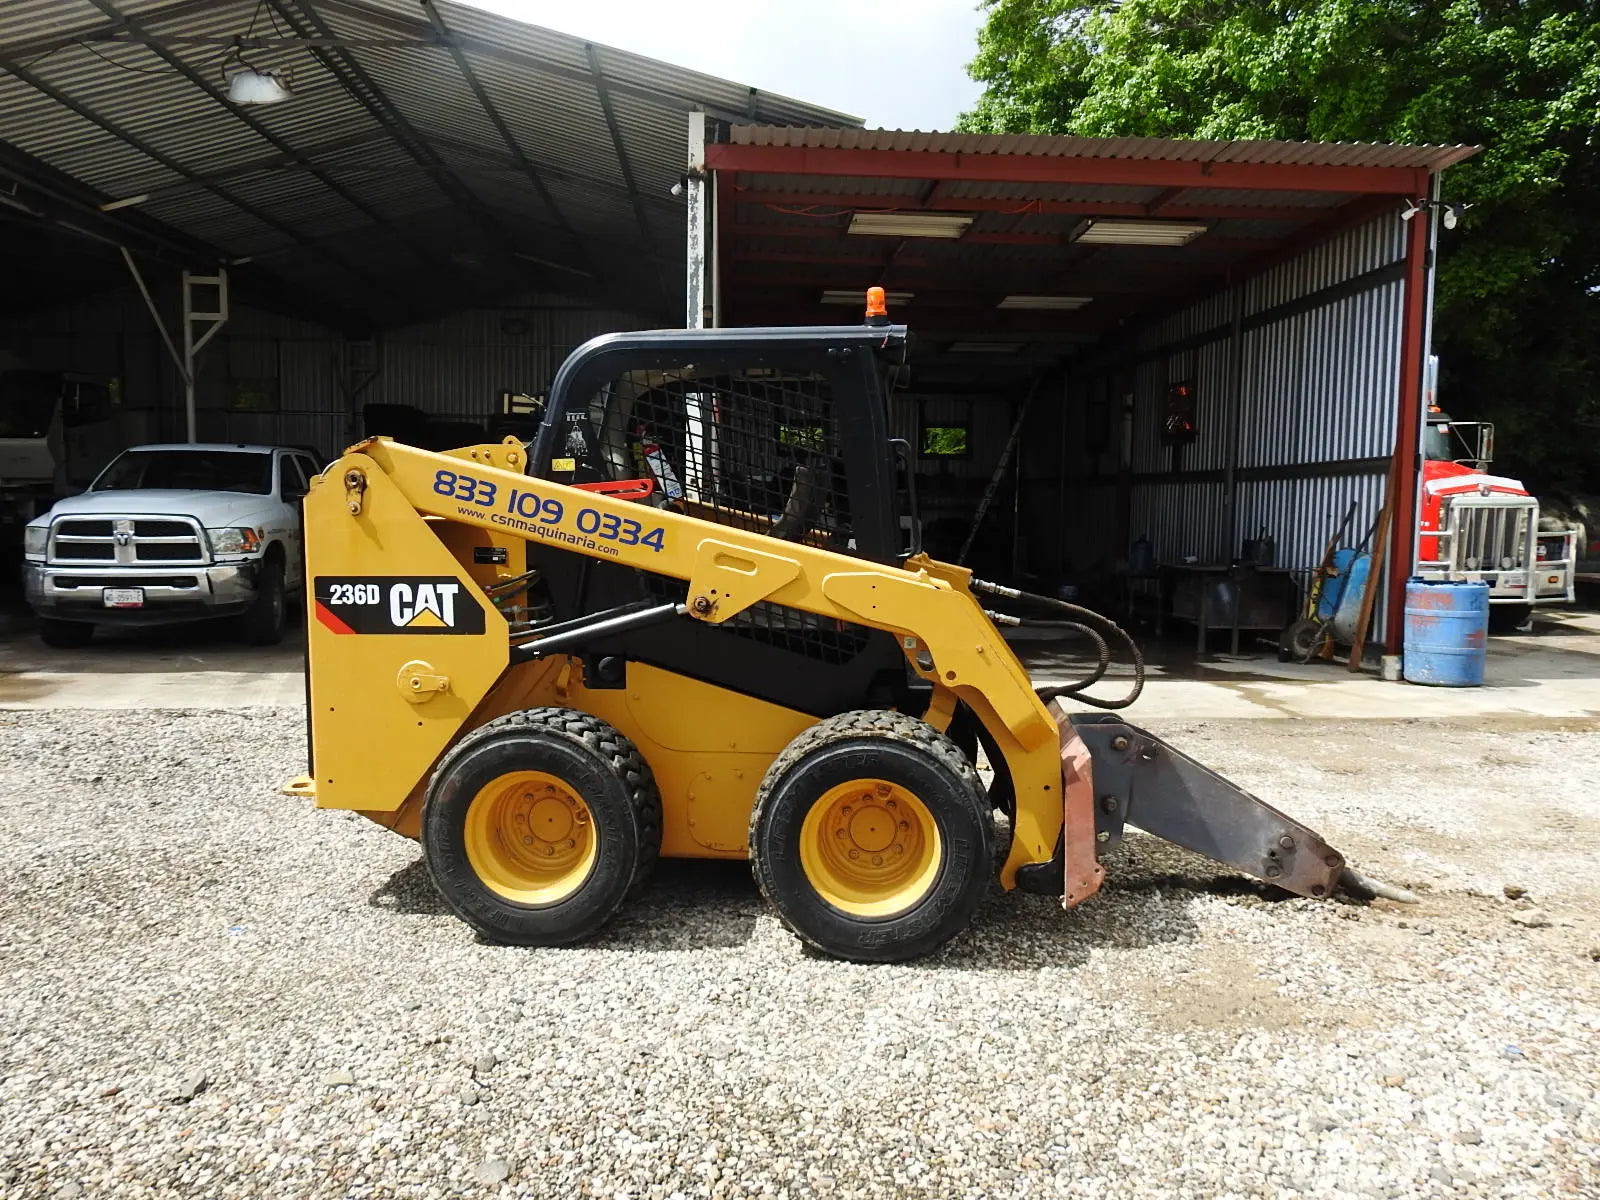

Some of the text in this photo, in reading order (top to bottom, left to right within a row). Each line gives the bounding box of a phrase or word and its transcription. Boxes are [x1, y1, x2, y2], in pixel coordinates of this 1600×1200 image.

[433, 470, 664, 552] 833 109 0334
[329, 583, 459, 627] 236D CAT
